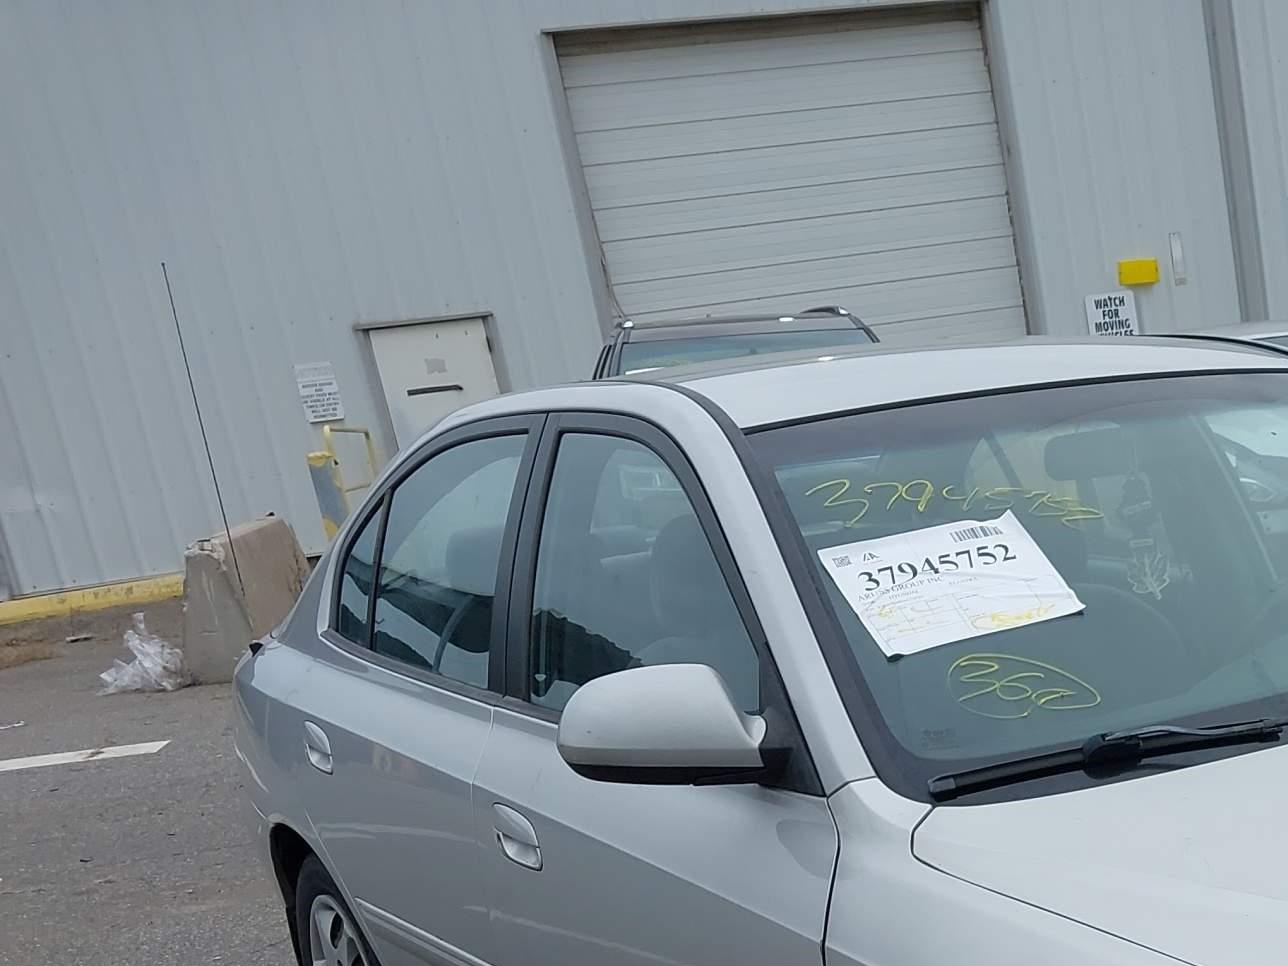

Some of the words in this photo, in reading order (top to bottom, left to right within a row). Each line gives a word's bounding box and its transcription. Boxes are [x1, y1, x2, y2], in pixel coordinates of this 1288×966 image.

[1094, 296, 1125, 310] WATCH
[1102, 309, 1120, 320] FOR
[1095, 318, 1131, 333] MOVING
[858, 544, 1017, 591] 37945752
